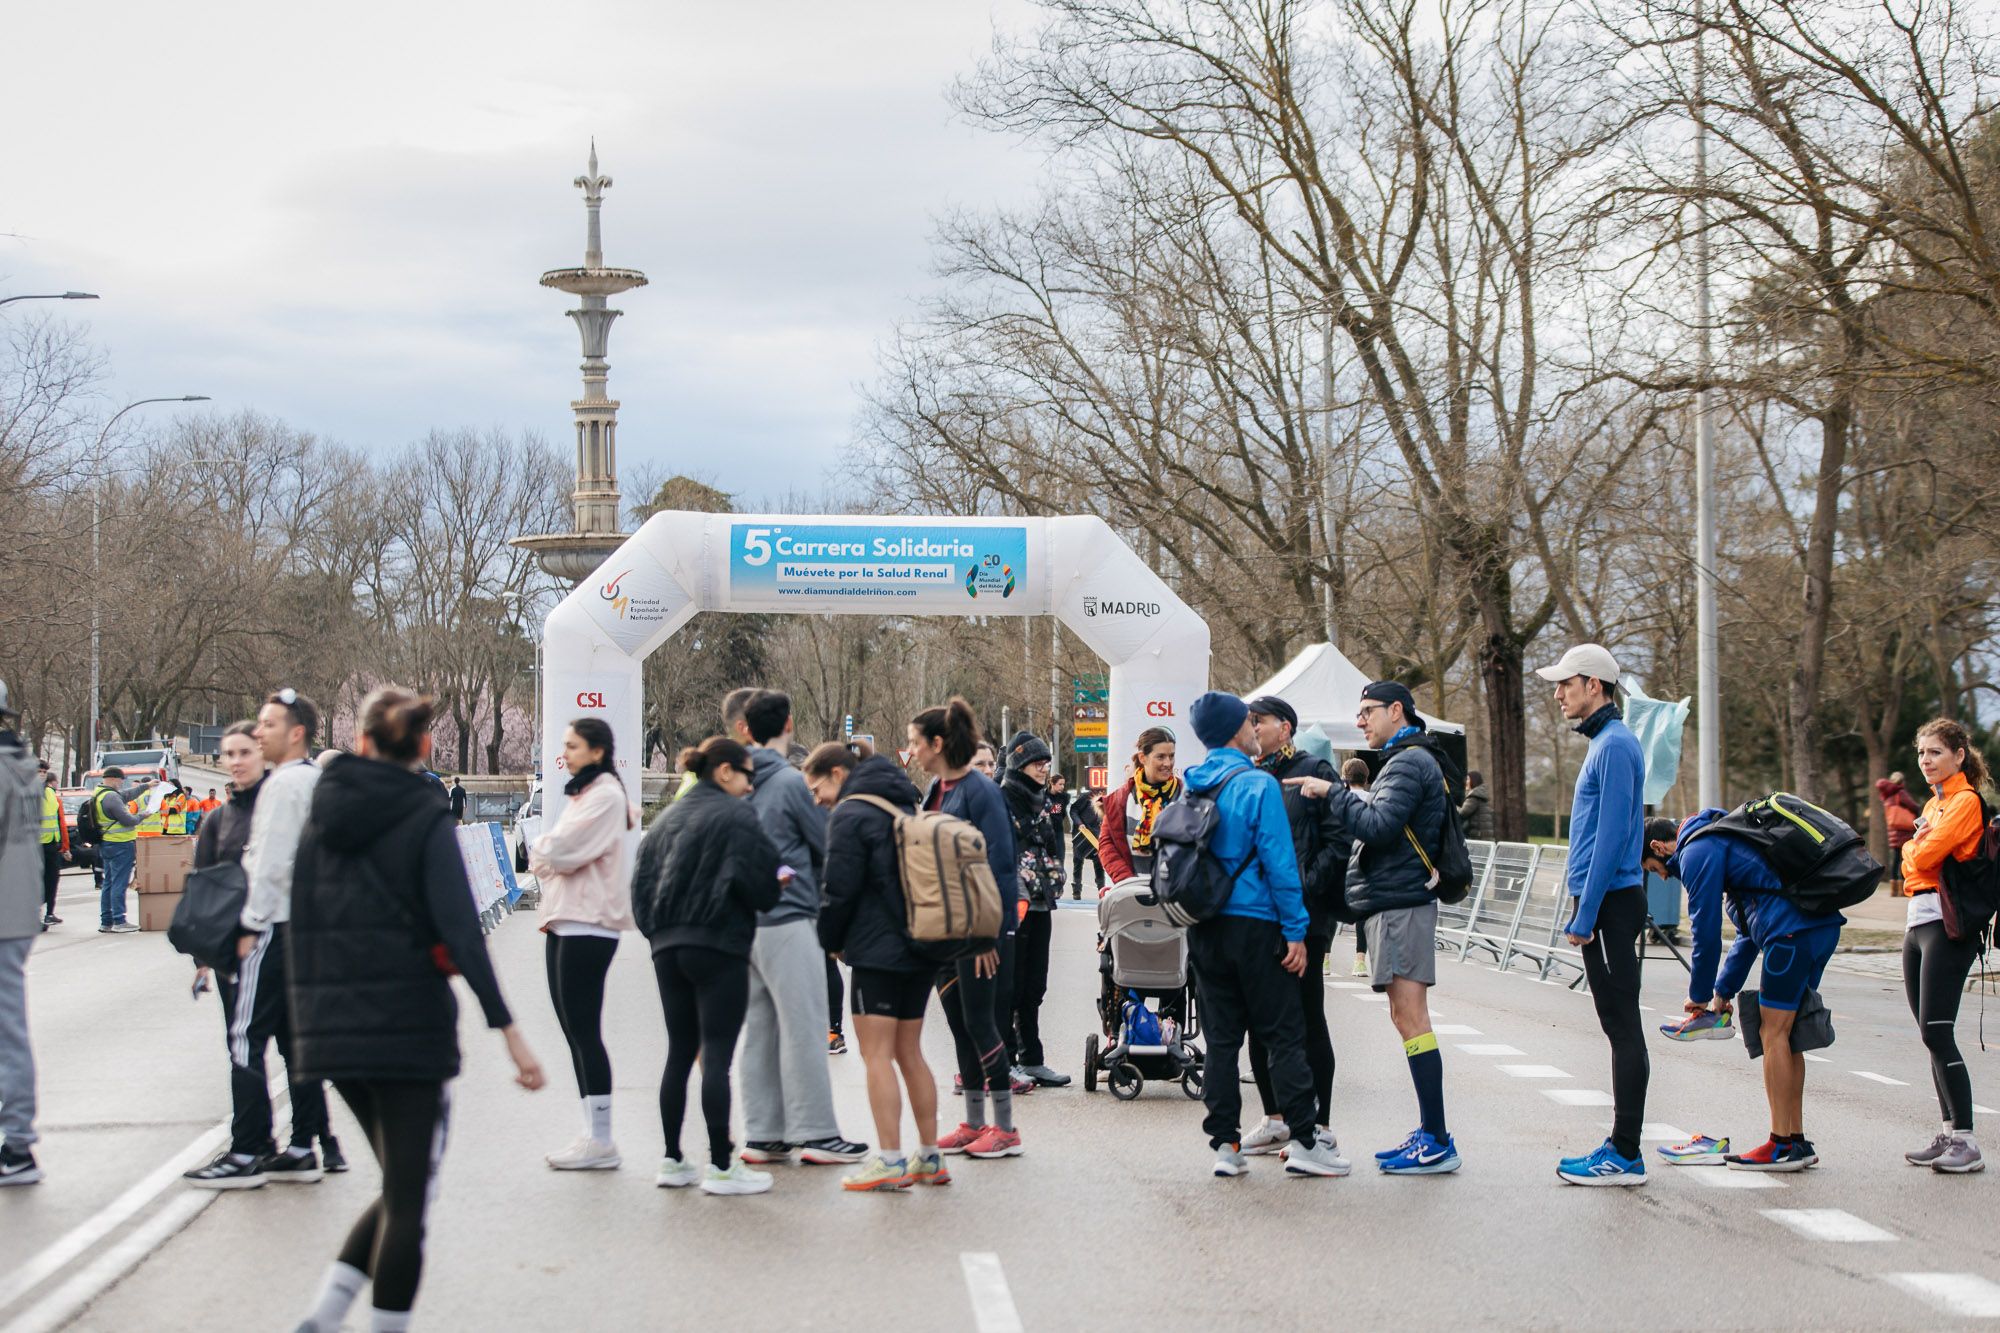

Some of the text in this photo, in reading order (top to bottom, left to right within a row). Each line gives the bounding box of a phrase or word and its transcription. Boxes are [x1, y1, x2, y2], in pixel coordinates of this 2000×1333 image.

[775, 536, 865, 556] Carrera
[872, 537, 974, 557] Solidaria
[784, 567, 947, 579] Muévete por la Salud Renal
[778, 586, 917, 597] www.diamundialdelriñon.com
[630, 606, 659, 614] Española
[1101, 602, 1160, 617] MADRID
[576, 692, 606, 708] CSL
[1146, 701, 1176, 717] CSL
